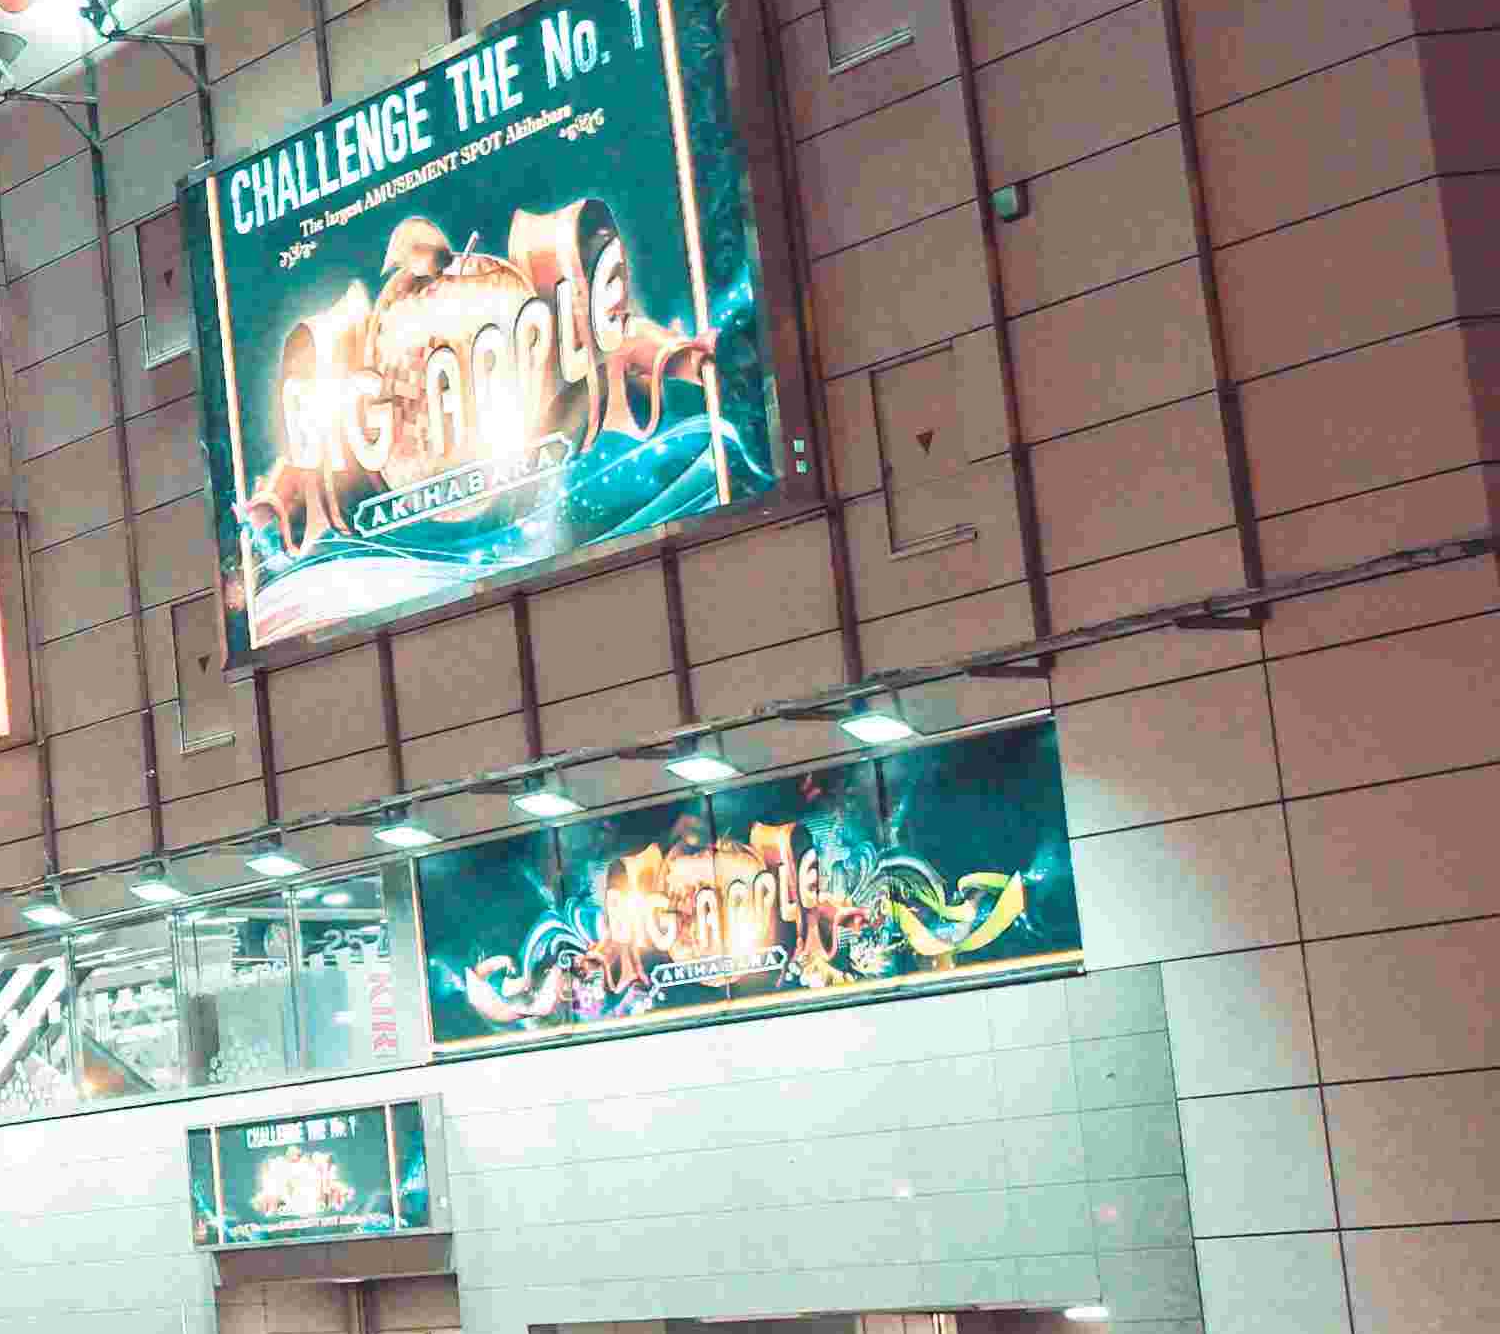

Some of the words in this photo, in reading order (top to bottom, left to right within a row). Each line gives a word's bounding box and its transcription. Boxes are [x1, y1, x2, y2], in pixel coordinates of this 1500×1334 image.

[230, 81, 433, 234] CHALLENGE
[446, 35, 524, 132] THE
[540, 9, 611, 89] No.
[300, 209, 324, 236] The
[364, 153, 458, 209] AMUSEMENT
[460, 130, 504, 165] SPOT
